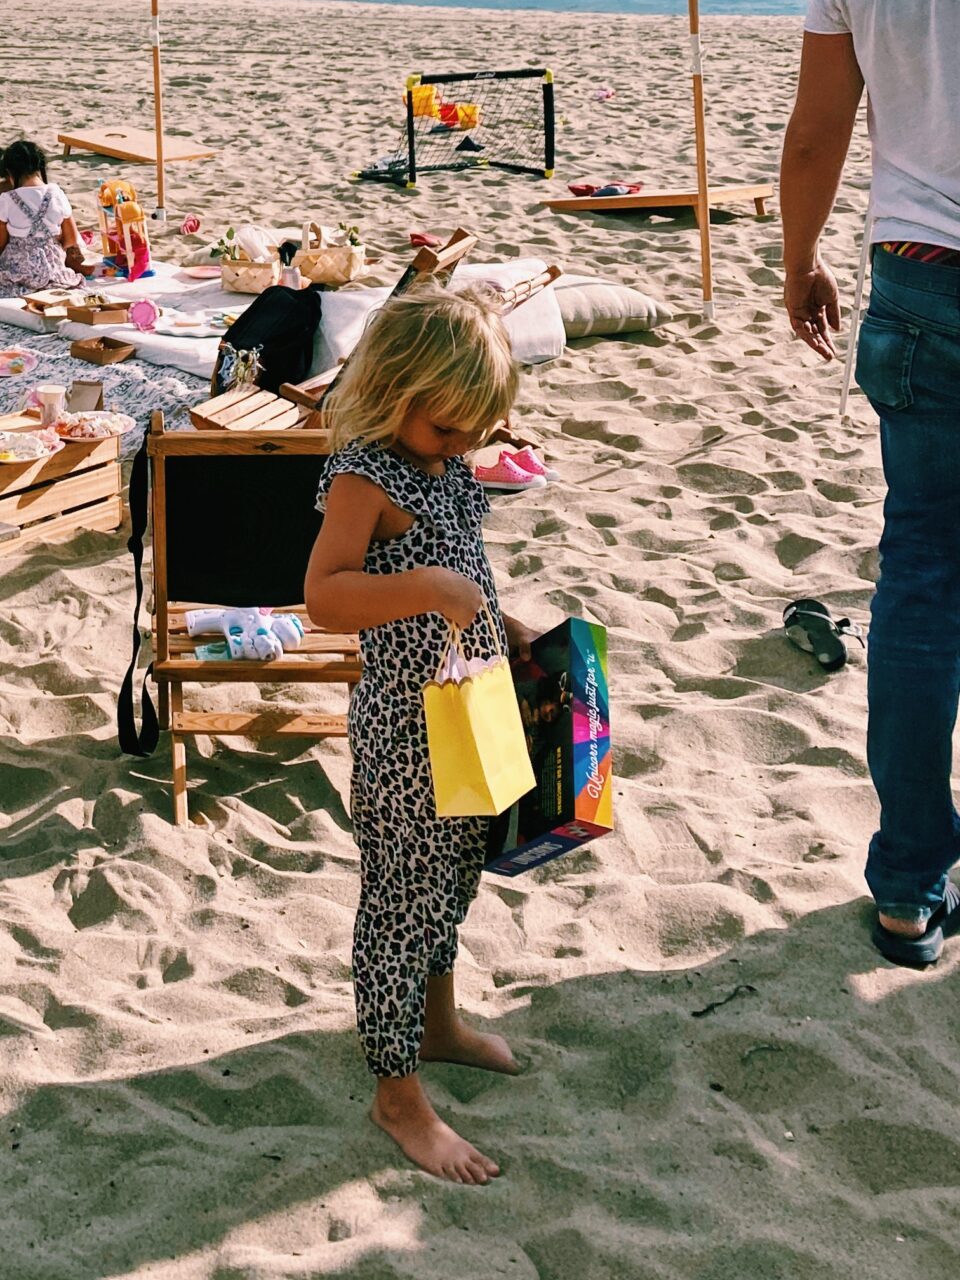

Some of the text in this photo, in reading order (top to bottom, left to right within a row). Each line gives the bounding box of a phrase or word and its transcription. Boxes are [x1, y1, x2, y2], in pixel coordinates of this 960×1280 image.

[586, 667, 598, 687] for
[585, 686, 599, 711] just
[587, 709, 602, 740] magic
[586, 743, 604, 799] Unicorn
